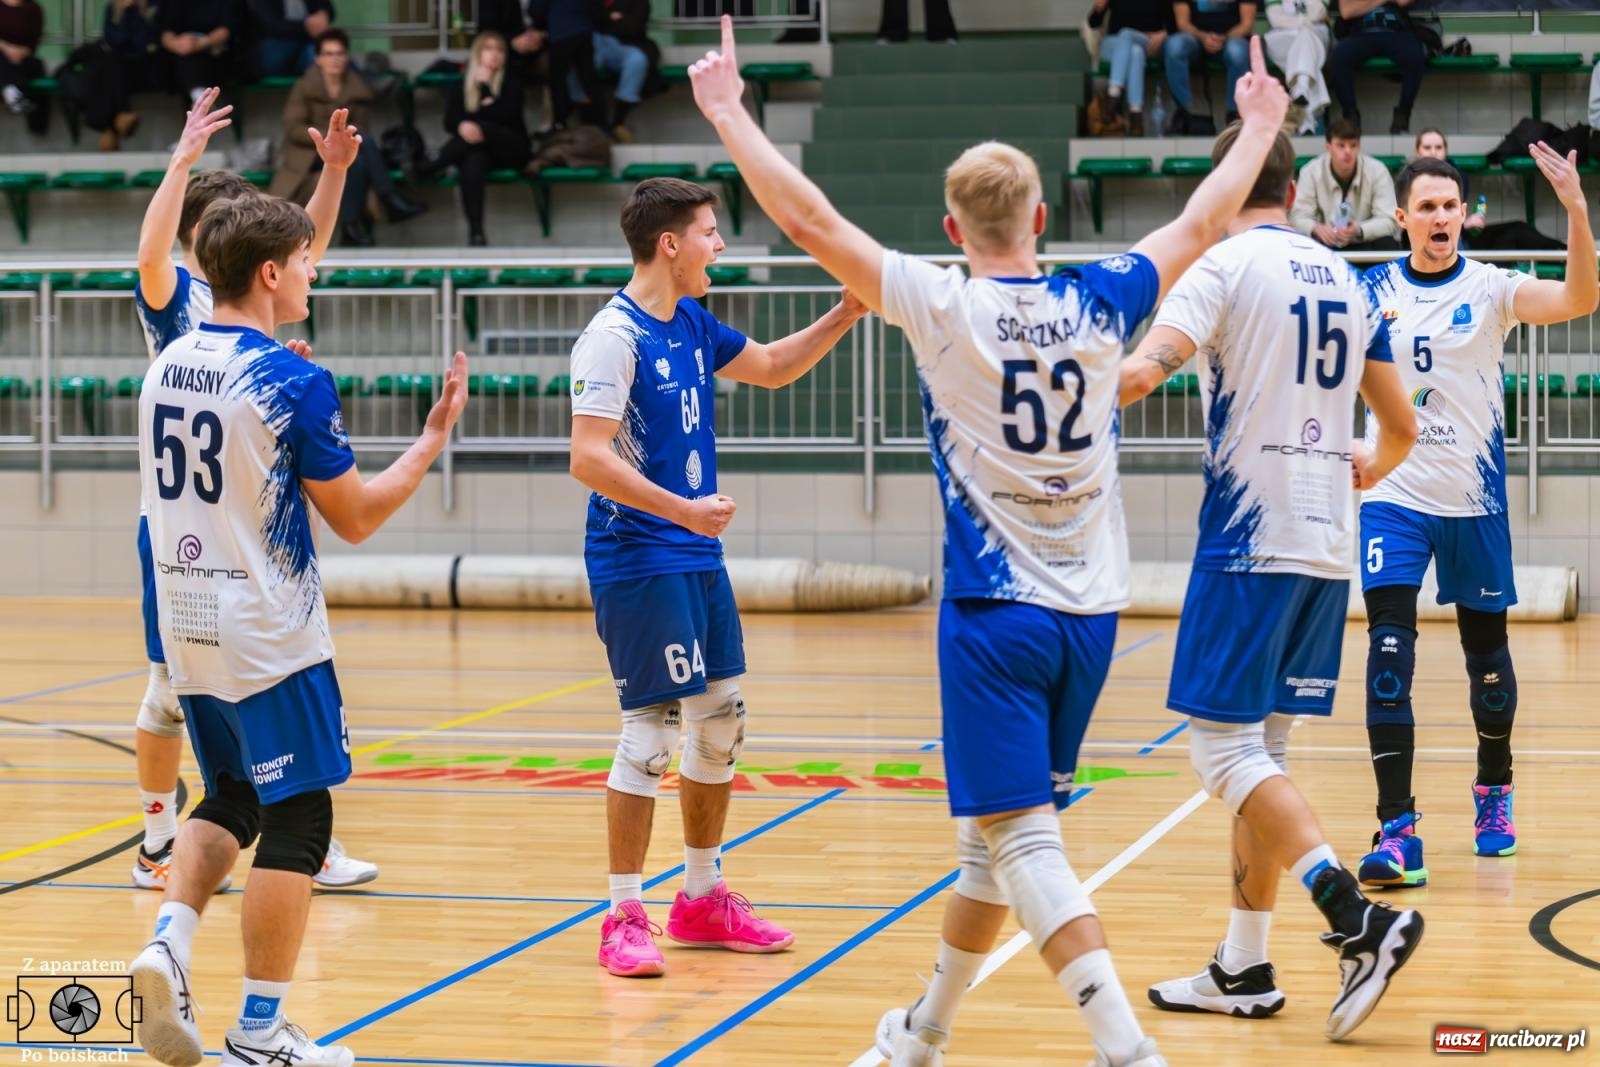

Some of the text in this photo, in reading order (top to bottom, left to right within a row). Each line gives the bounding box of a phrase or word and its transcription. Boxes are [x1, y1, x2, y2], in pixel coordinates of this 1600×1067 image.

[1289, 260, 1336, 286] PLUTA
[1289, 295, 1348, 390] 15
[1413, 335, 1433, 373] 5
[160, 363, 226, 395] KWAŚNY
[680, 386, 700, 434] 64
[1001, 358, 1093, 455] 52
[153, 403, 223, 504] 53
[1366, 536, 1384, 574] 5
[664, 638, 706, 684] 64
[256, 753, 294, 774] CONCEPT
